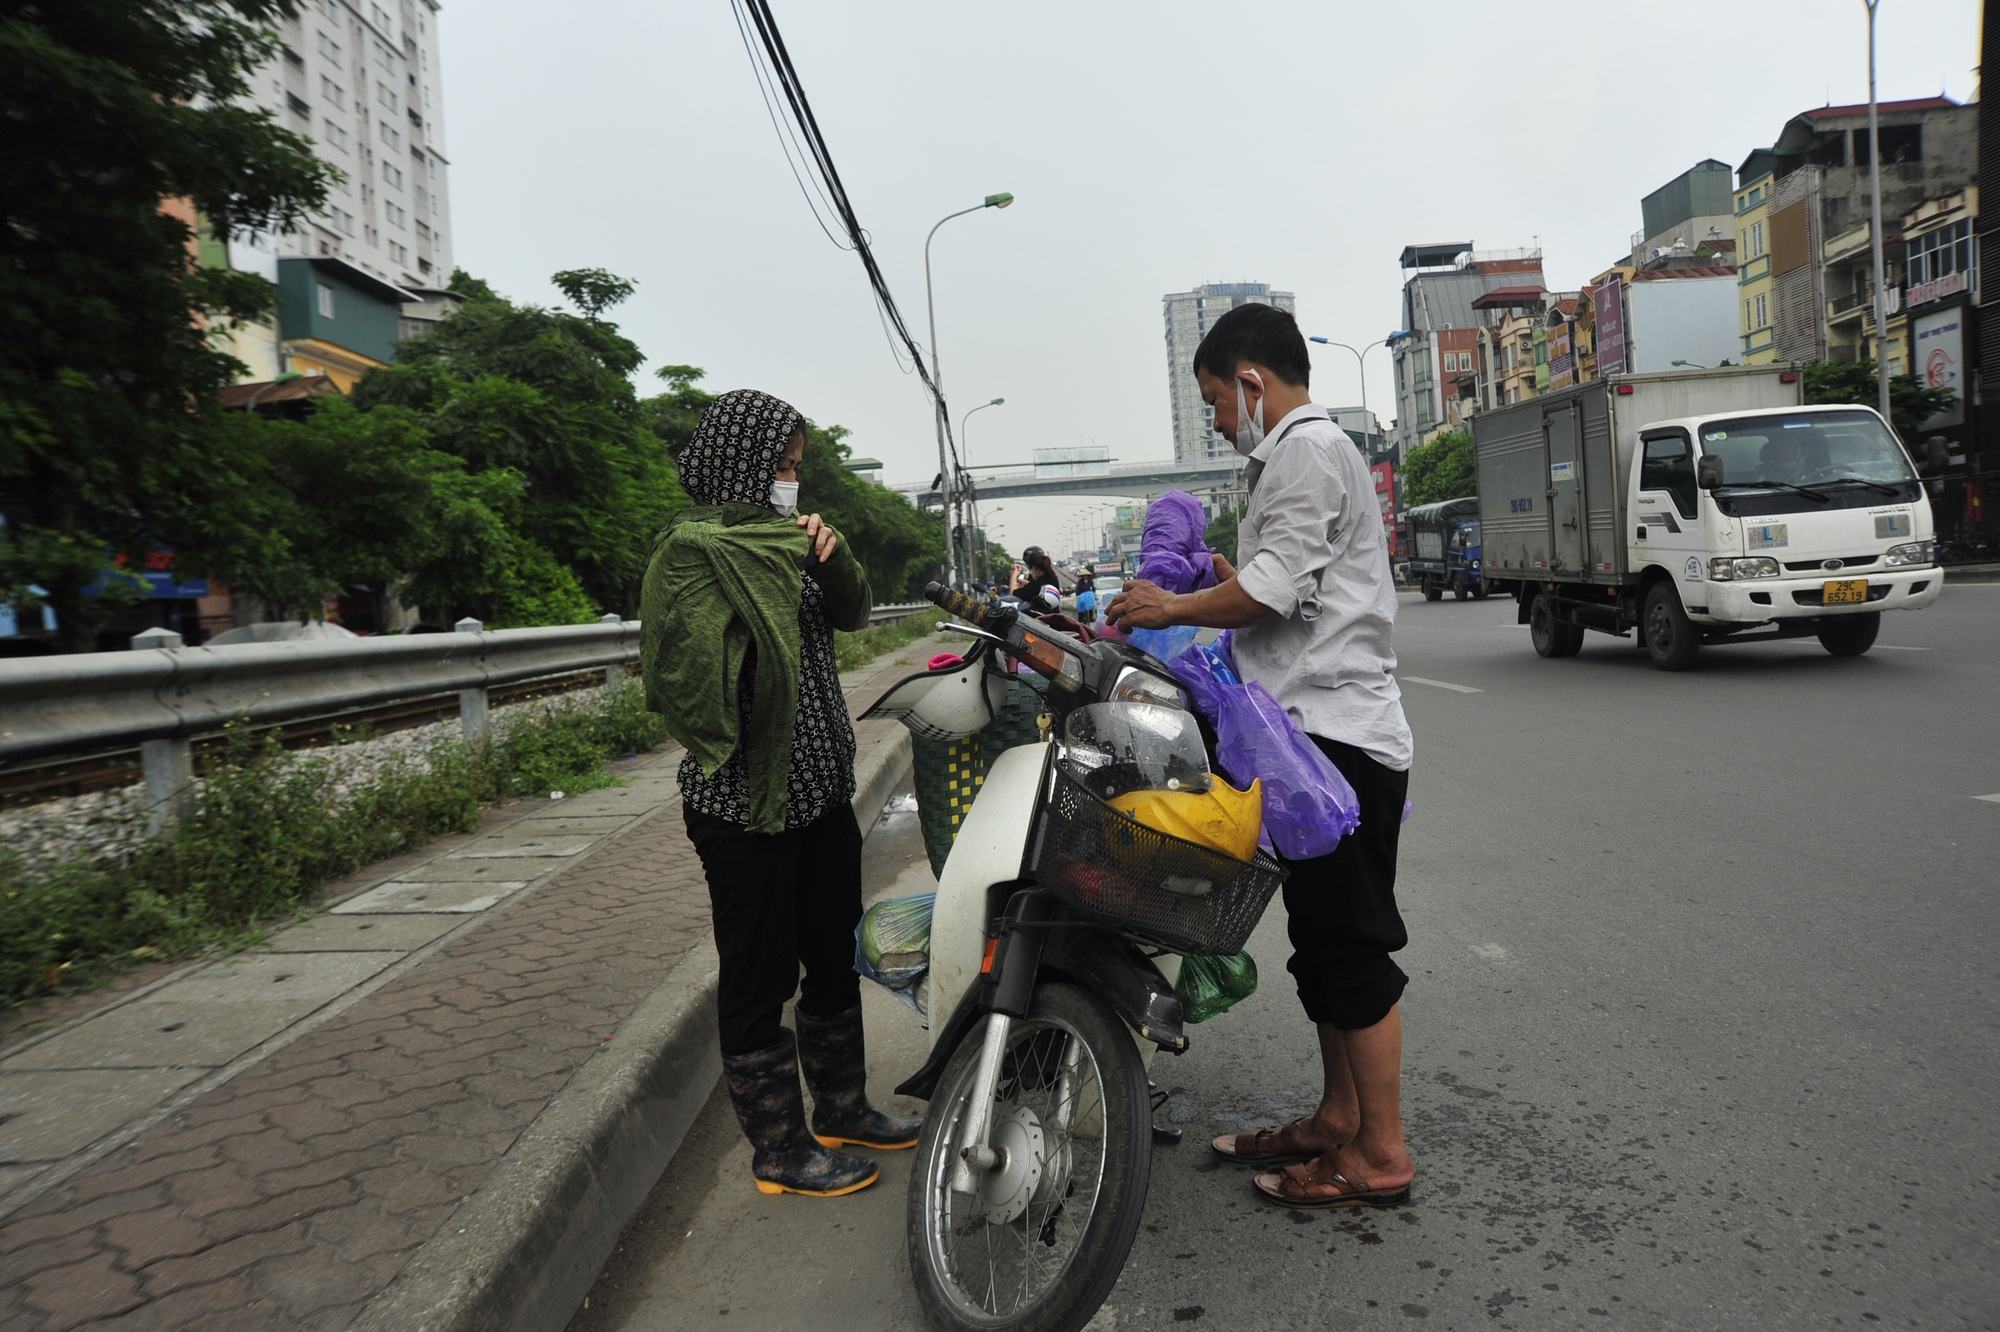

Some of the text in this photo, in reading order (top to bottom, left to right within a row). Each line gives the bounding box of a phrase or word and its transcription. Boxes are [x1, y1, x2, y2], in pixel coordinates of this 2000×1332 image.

[1745, 517, 1780, 525] THACO
[1747, 523, 1788, 544] HLX
[1826, 561, 1841, 569] KIA
[1836, 581, 1856, 592] 29C
[1828, 591, 1863, 602] 652.19
